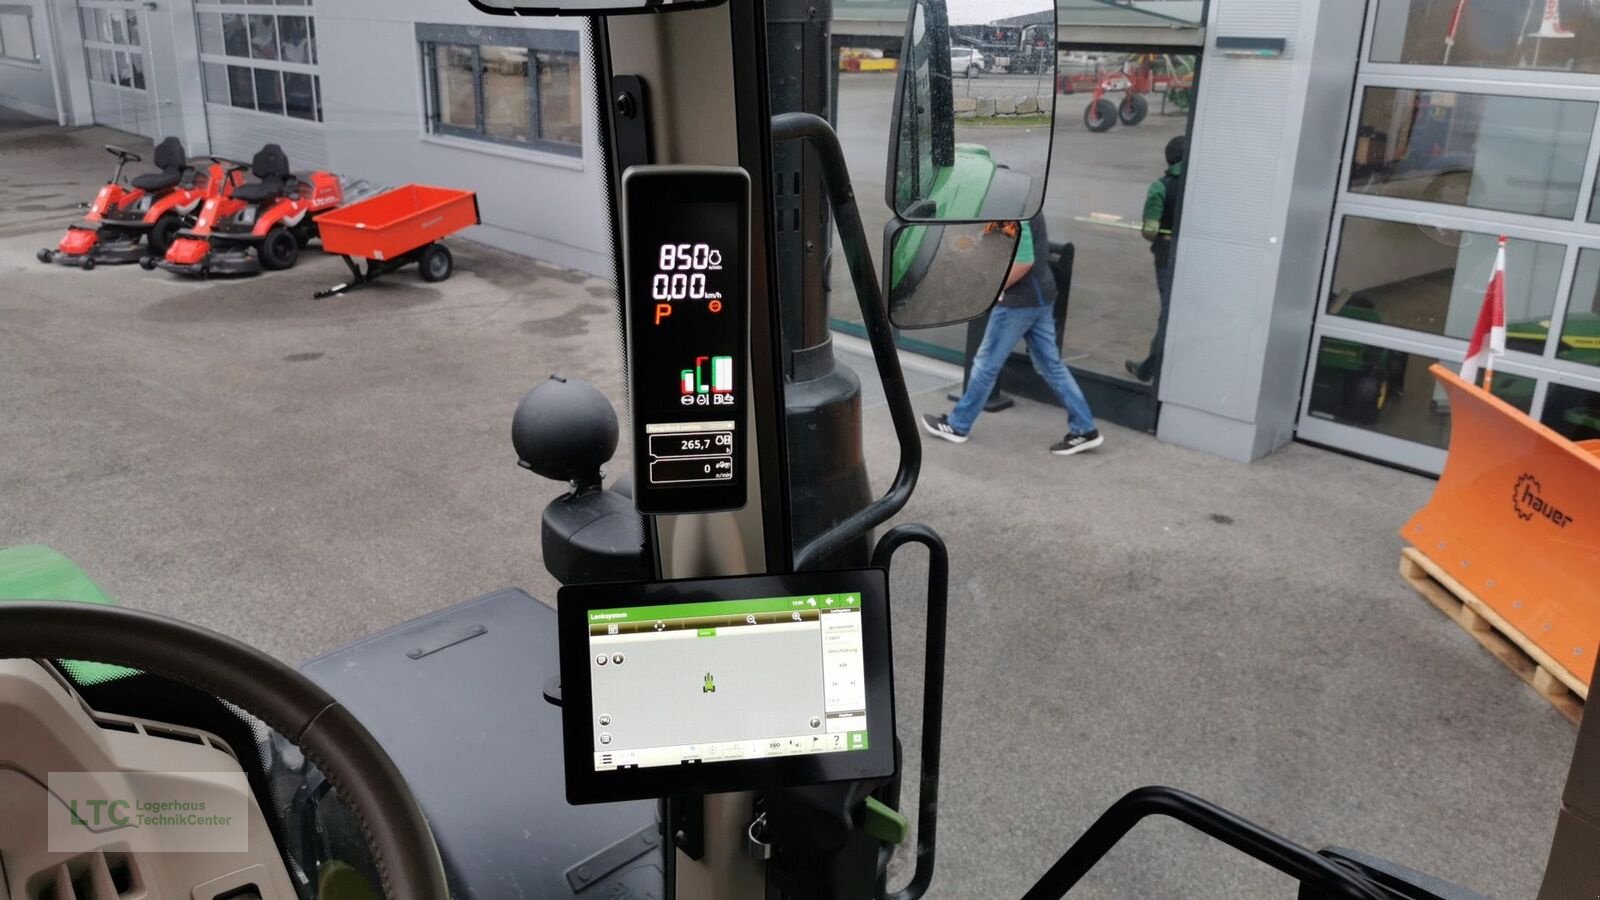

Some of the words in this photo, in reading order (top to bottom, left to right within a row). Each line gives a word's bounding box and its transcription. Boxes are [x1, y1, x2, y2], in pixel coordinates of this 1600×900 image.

[660, 244, 709, 270] 850
[653, 273, 706, 301] 0,00
[655, 303, 672, 325] P
[681, 439, 711, 450] 265,7
[704, 464, 711, 474] 0
[1521, 484, 1573, 528] hauer
